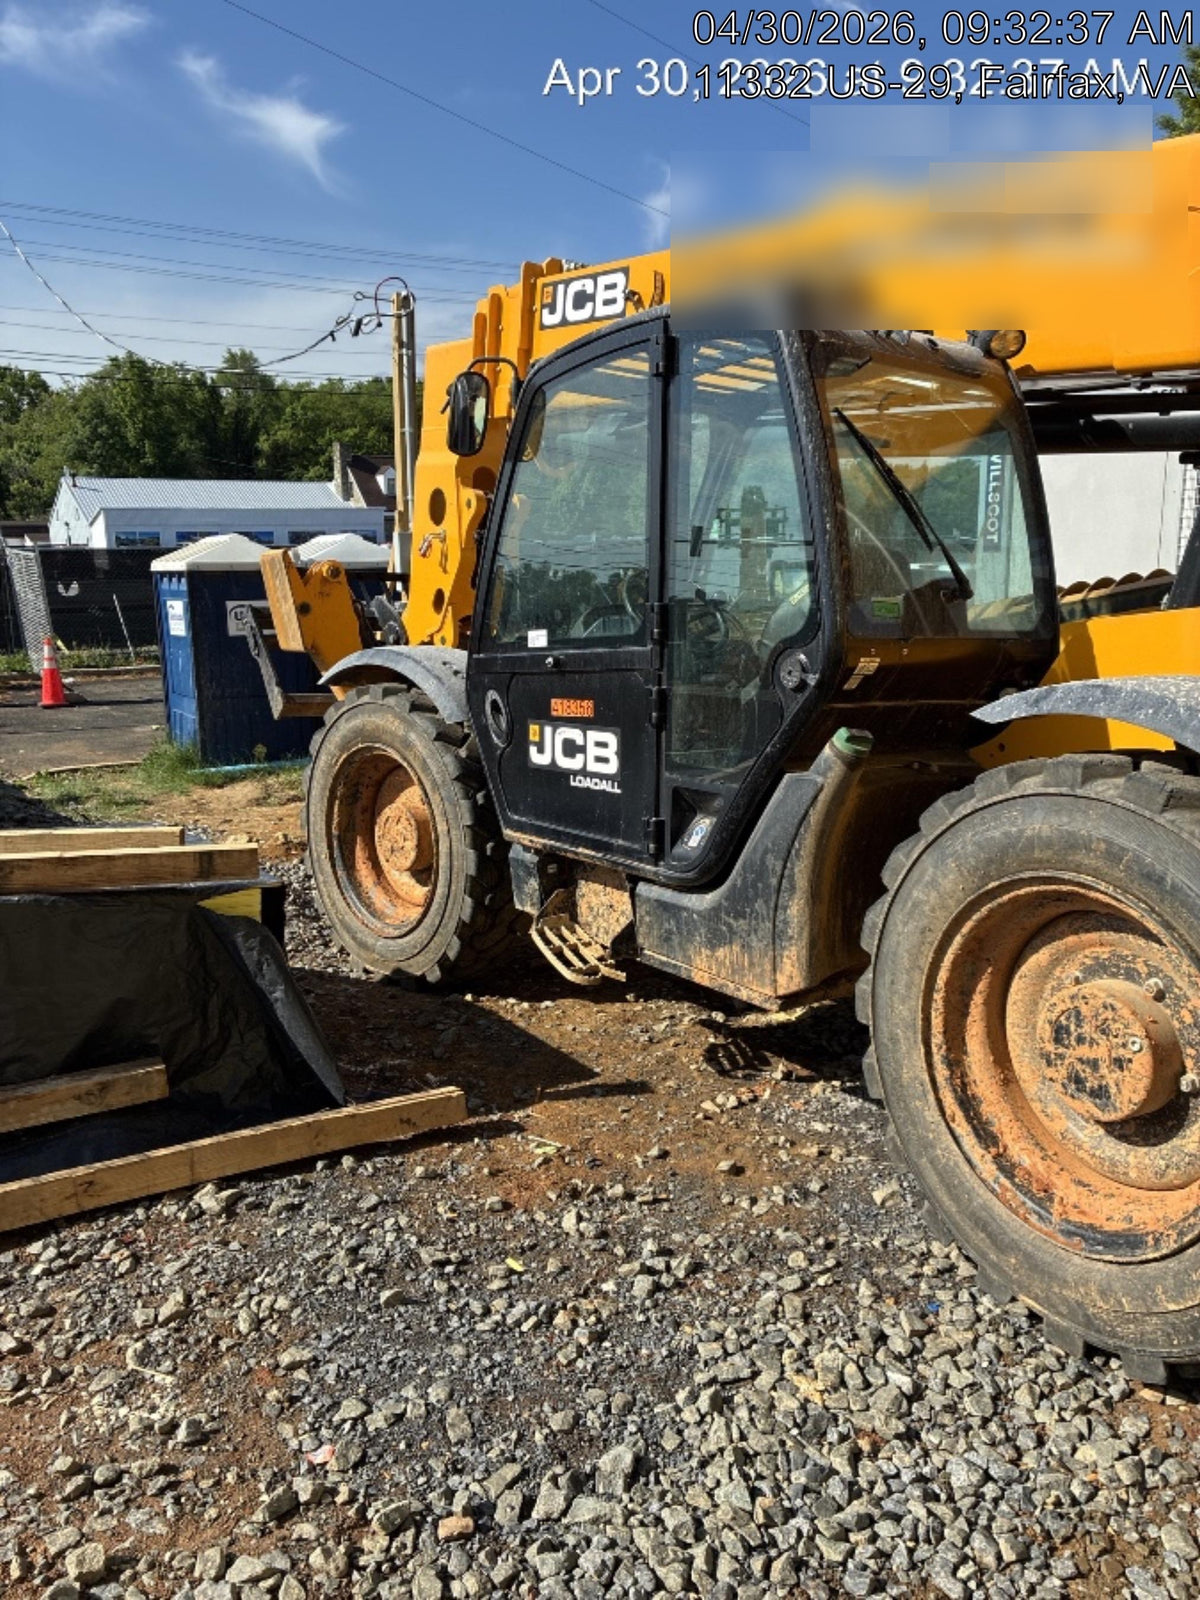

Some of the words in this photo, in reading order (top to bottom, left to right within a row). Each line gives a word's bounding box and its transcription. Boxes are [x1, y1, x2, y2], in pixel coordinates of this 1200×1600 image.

[542, 272, 626, 326] JCB
[529, 725, 620, 774] JCB
[570, 775, 621, 793] LOADALL
